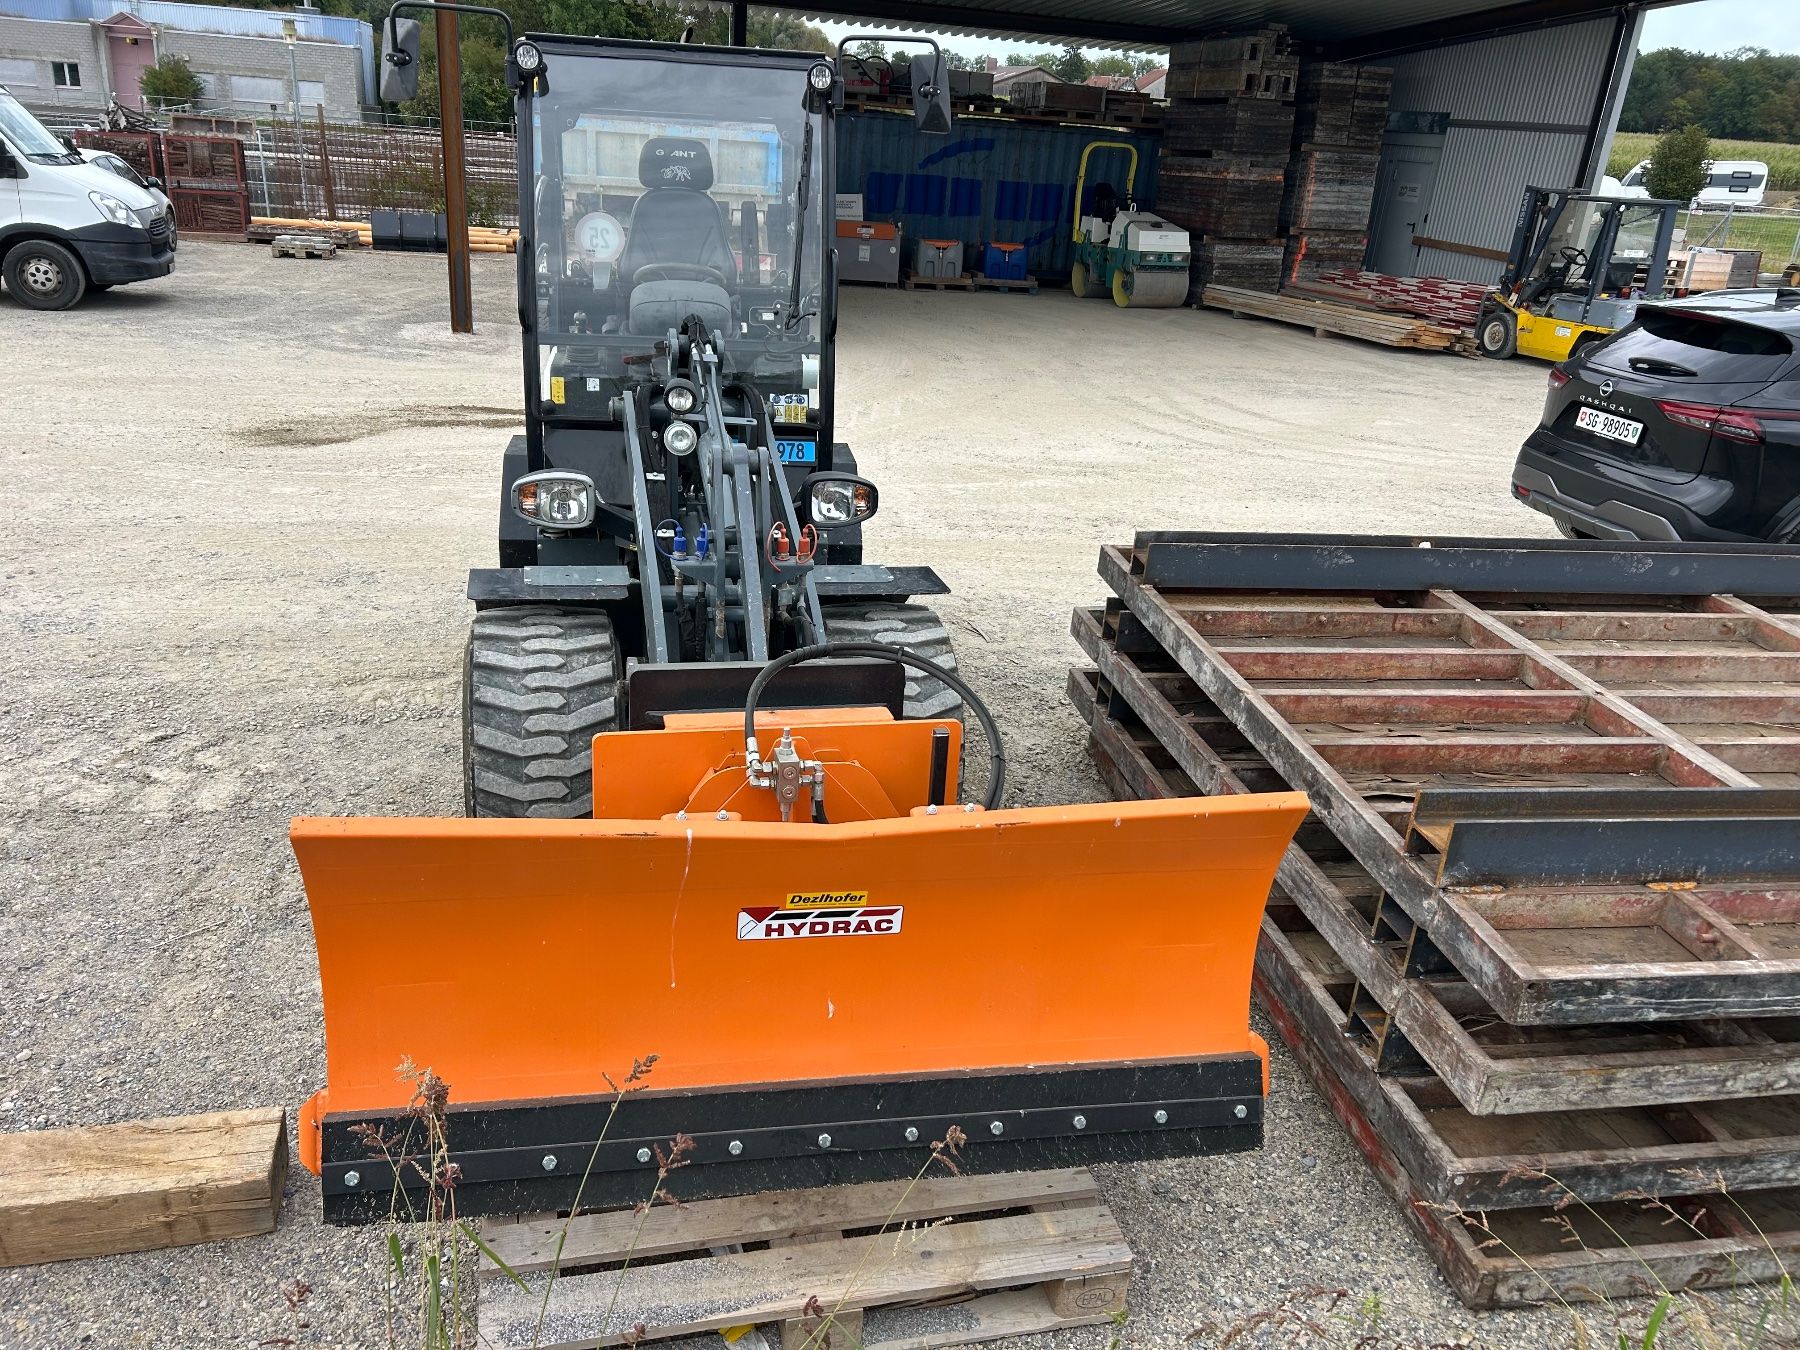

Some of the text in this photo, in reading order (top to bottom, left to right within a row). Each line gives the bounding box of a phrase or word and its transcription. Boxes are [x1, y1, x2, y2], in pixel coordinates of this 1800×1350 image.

[1517, 192, 1530, 228] NISSAN
[1579, 394, 1632, 414] QASHQAI
[789, 893, 866, 905] Dezlhofer
[764, 918, 894, 938] HYDRAC
[1081, 1292, 1111, 1306] EPAL
